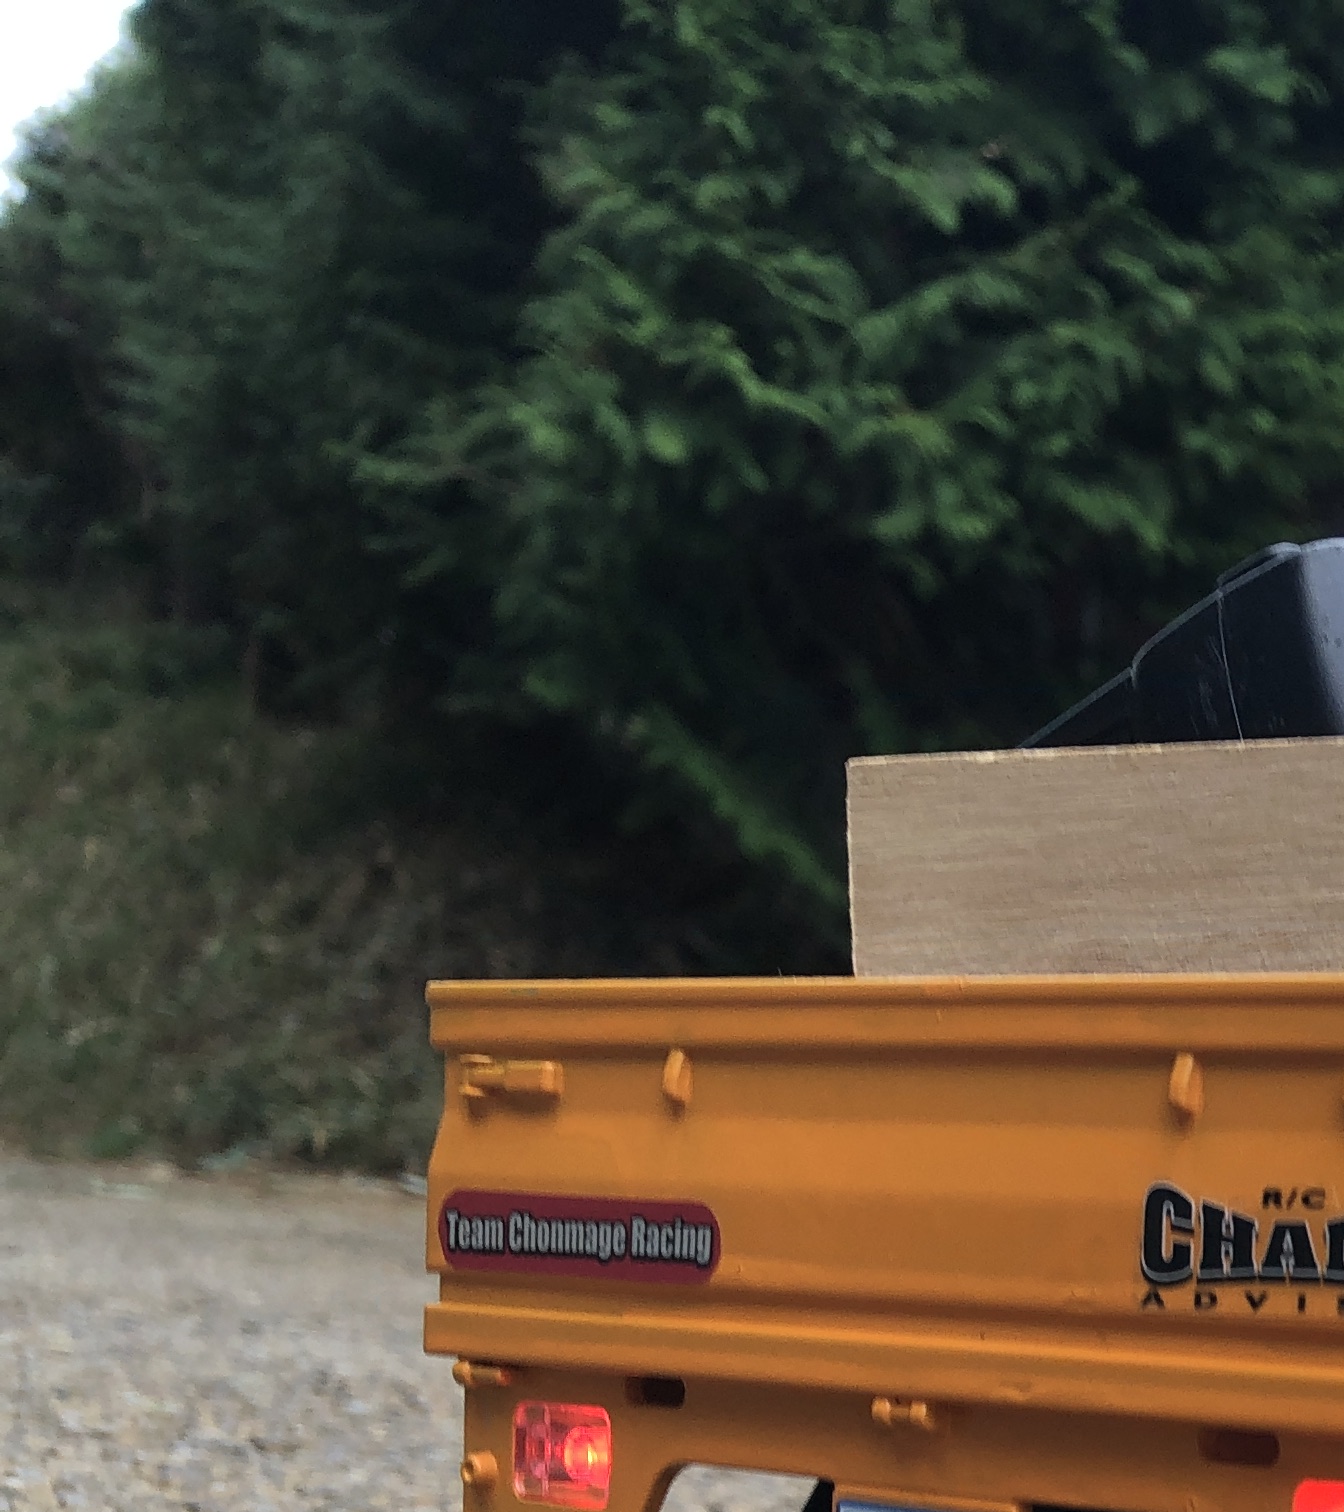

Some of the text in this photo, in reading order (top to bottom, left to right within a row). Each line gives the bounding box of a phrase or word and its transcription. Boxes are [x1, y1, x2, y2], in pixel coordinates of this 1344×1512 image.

[1261, 1186, 1327, 1211] R/C
[446, 1208, 712, 1267] Team Chonmage Racing
